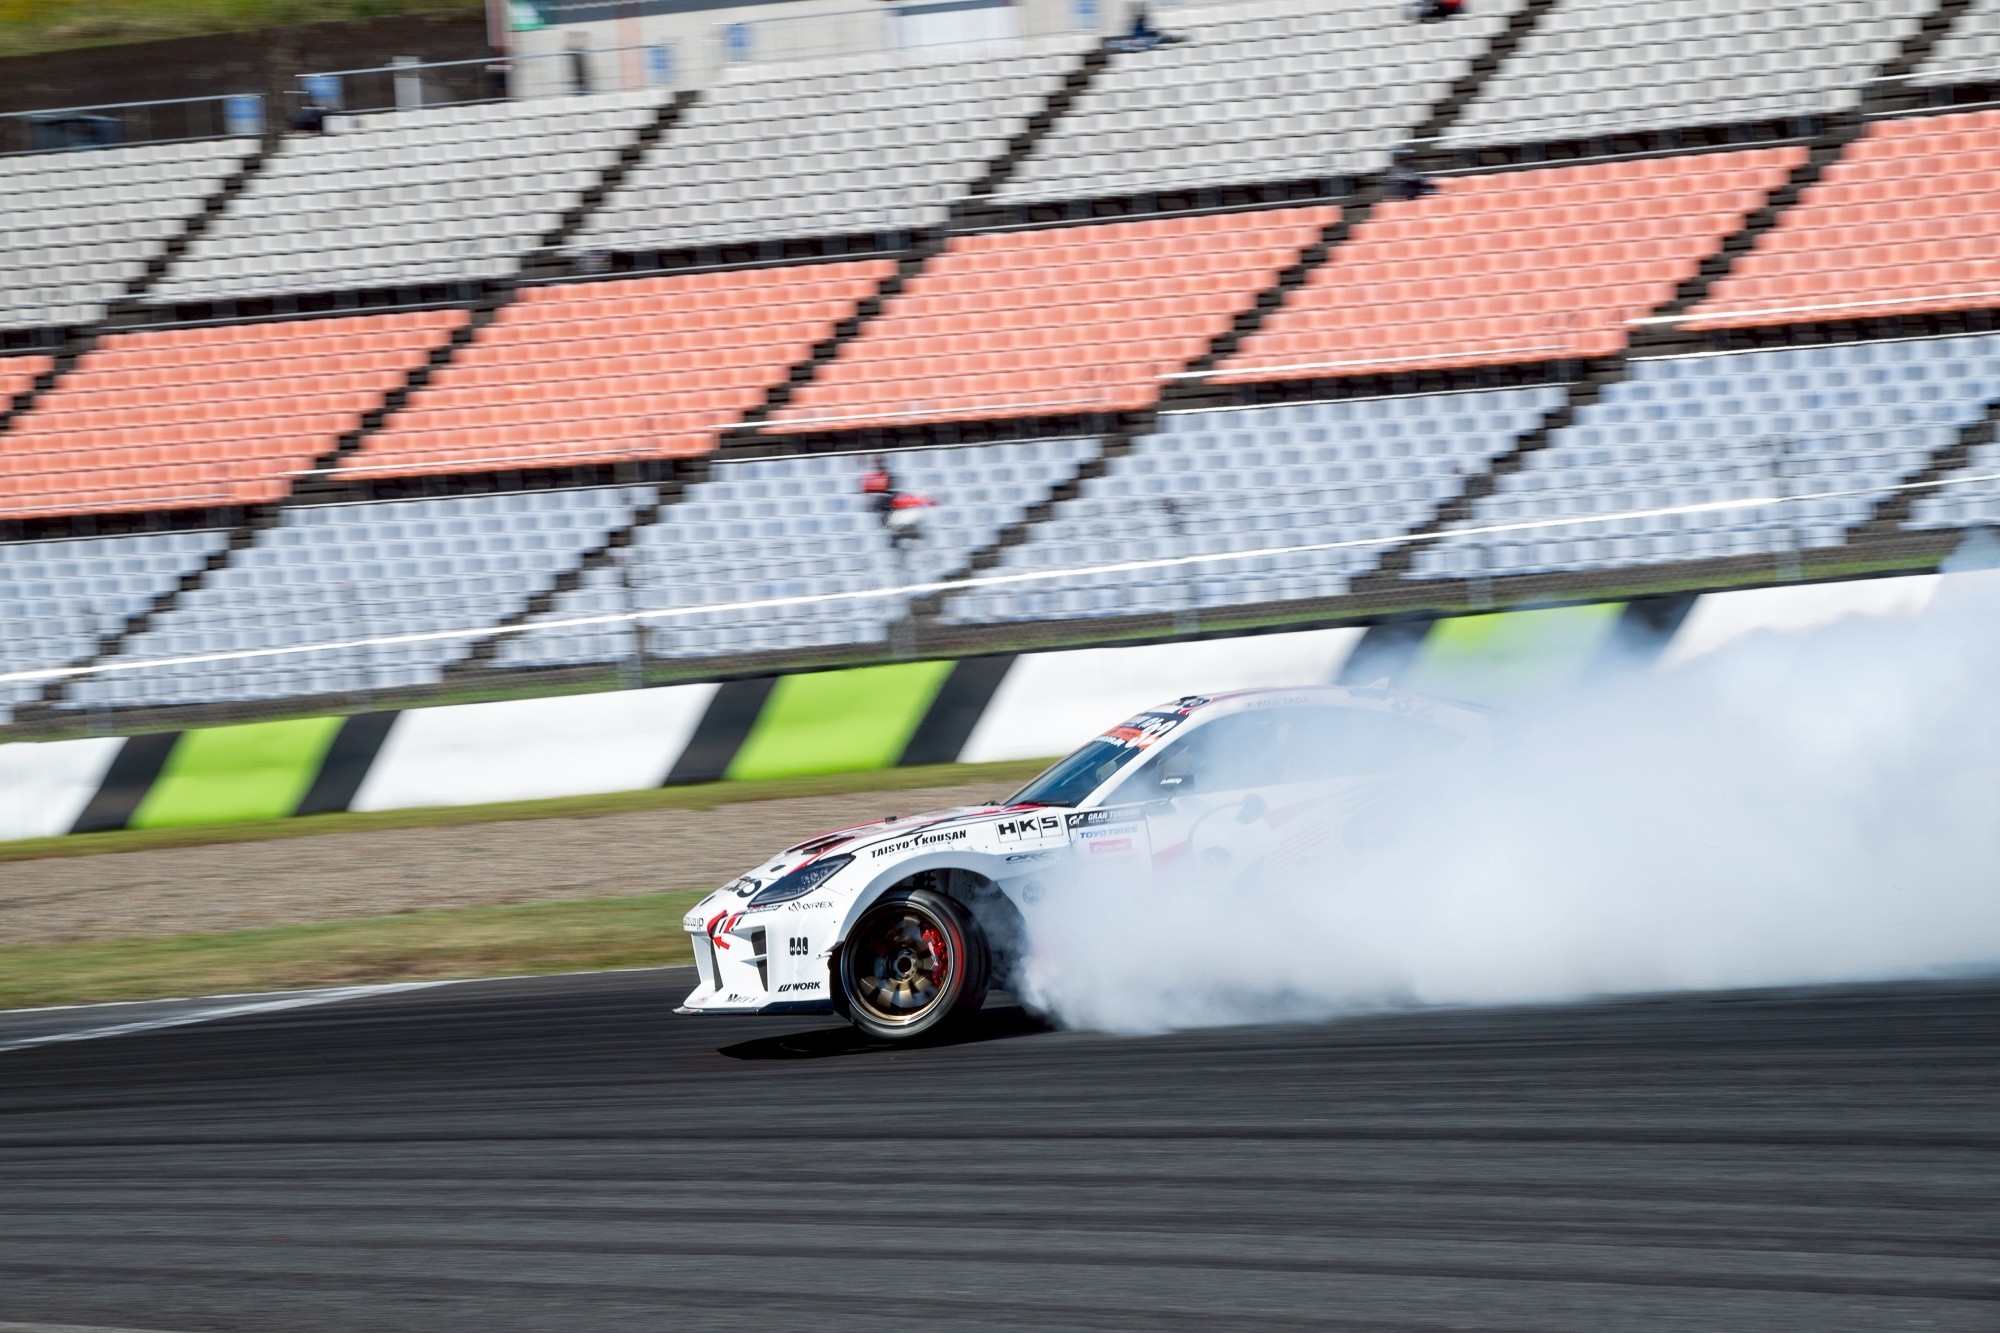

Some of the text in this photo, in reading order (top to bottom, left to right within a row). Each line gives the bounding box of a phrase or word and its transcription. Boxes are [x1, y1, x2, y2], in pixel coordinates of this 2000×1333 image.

[1088, 811, 1108, 821] GRAN
[998, 816, 1058, 835] HKS
[1080, 826, 1138, 839] TOYO TIRES
[871, 841, 909, 858] TAISYO
[922, 830, 967, 844] KOUSAN
[792, 981, 820, 990] WORK
